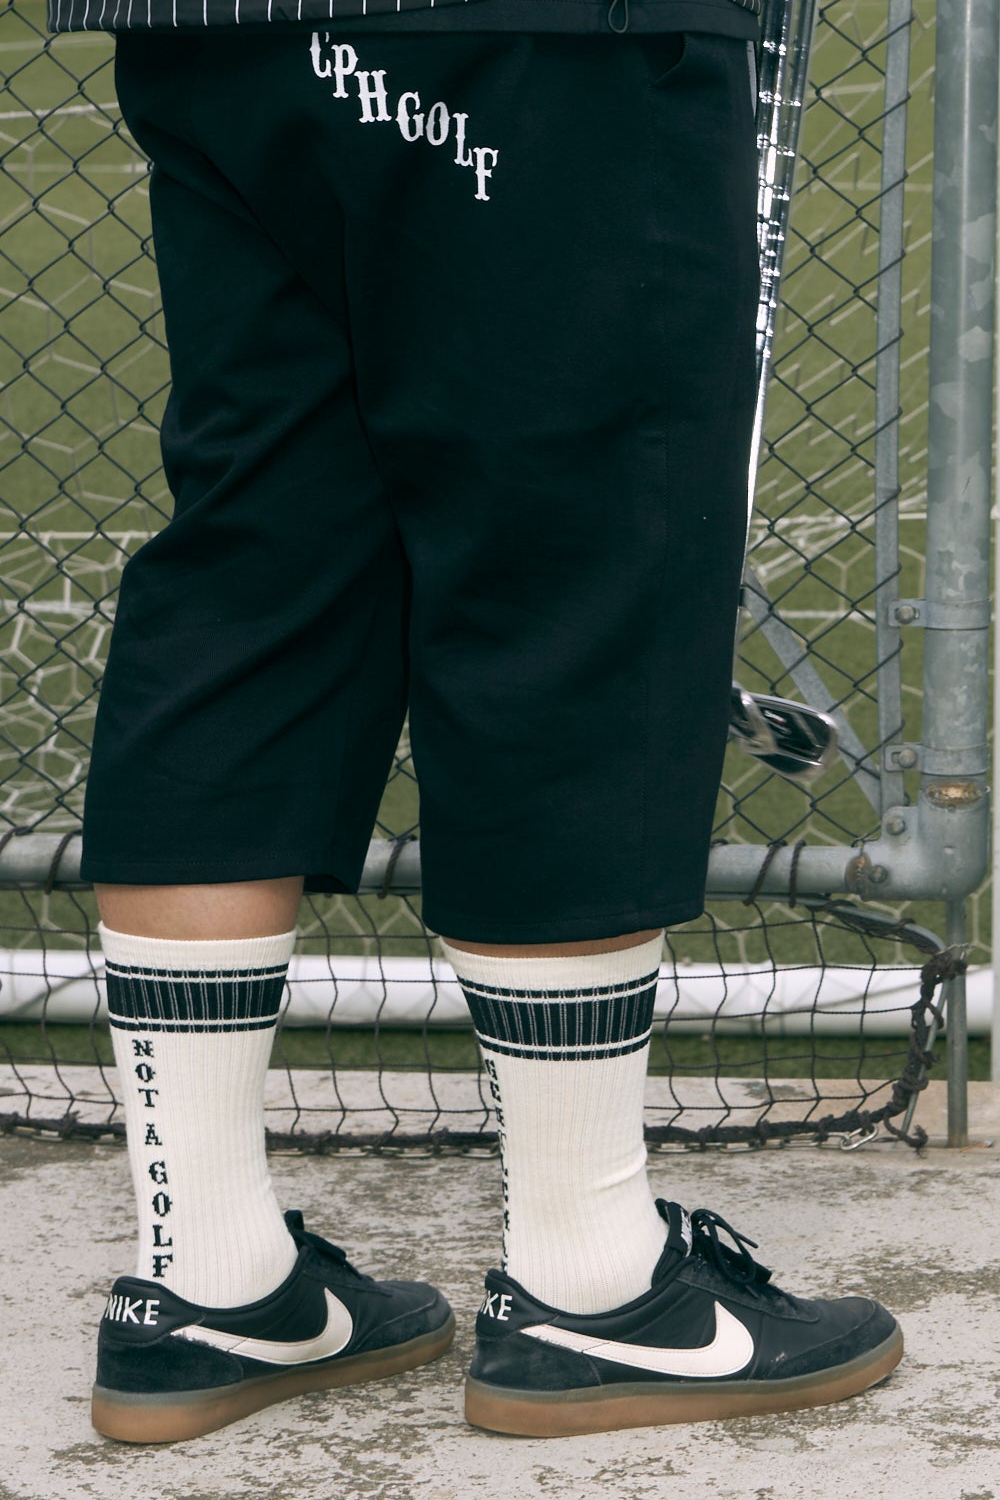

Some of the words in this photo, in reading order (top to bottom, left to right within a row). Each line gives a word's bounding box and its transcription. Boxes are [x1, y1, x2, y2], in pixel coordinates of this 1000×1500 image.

[132, 1039, 159, 1108] NOT
[145, 1122, 163, 1146] A
[148, 1161, 173, 1278] GOLF
[105, 1293, 160, 1326] NIKE
[481, 1290, 513, 1321] KE
